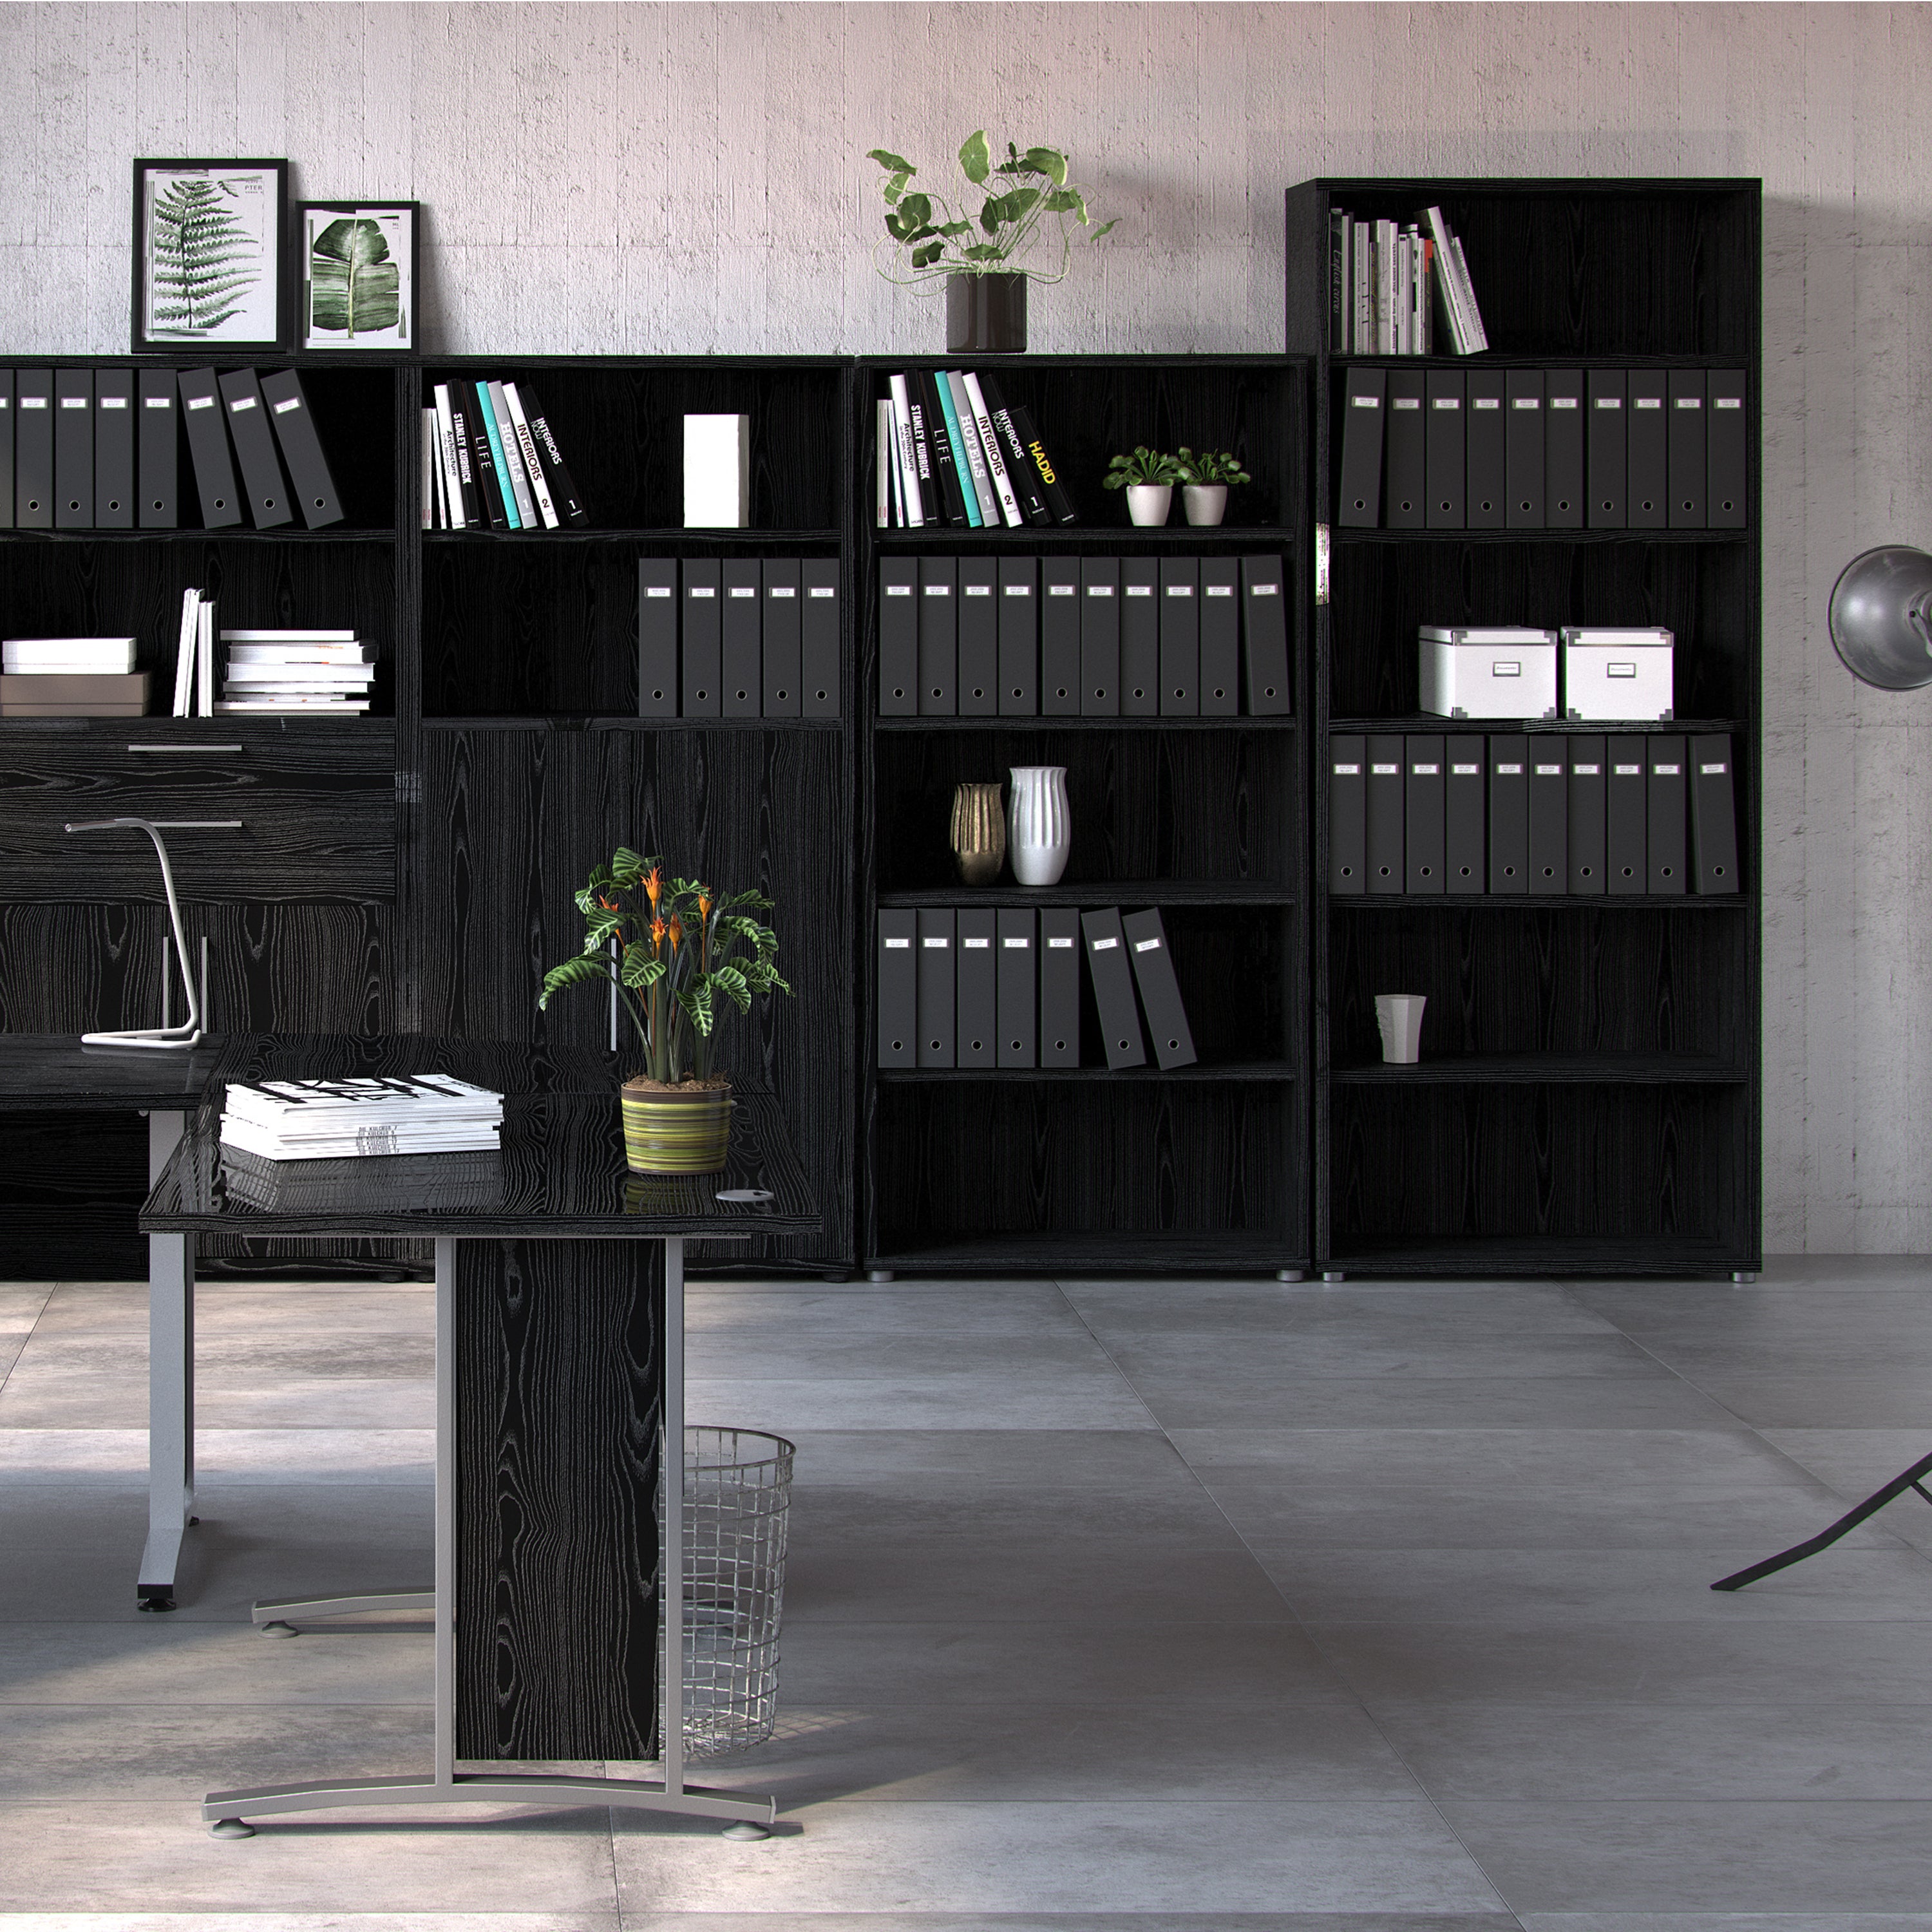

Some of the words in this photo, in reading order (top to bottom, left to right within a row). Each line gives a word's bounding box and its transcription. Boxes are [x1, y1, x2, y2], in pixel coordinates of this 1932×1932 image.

[1331, 249, 1341, 285] English
[453, 413, 467, 447] STANLEY
[911, 404, 925, 440] STANLEY
[447, 430, 457, 477] Architecture
[458, 448, 472, 484] KUBRICK
[476, 436, 491, 469] LIFE
[488, 424, 500, 453] AUDREY
[496, 453, 509, 488] HEPBURN
[500, 421, 525, 483] HOTELS
[523, 498, 529, 509] 1
[517, 423, 542, 481] INTERIORS
[542, 498, 549, 508] 2
[536, 417, 562, 465] INTERIORS
[569, 499, 576, 510] 1
[904, 422, 914, 472] Architecture
[916, 442, 930, 480] KUBRICK
[934, 429, 951, 464] LIFE
[947, 416, 961, 446] AUDREY
[955, 446, 969, 484] HEPBURN
[960, 413, 985, 479] HOTELS
[984, 495, 990, 506] 1
[978, 416, 1005, 477] INTERIORS
[1004, 495, 1013, 506] 2
[998, 408, 1025, 460] INTERIORS
[1030, 496, 1038, 507] 1
[1028, 440, 1056, 484] HADID
